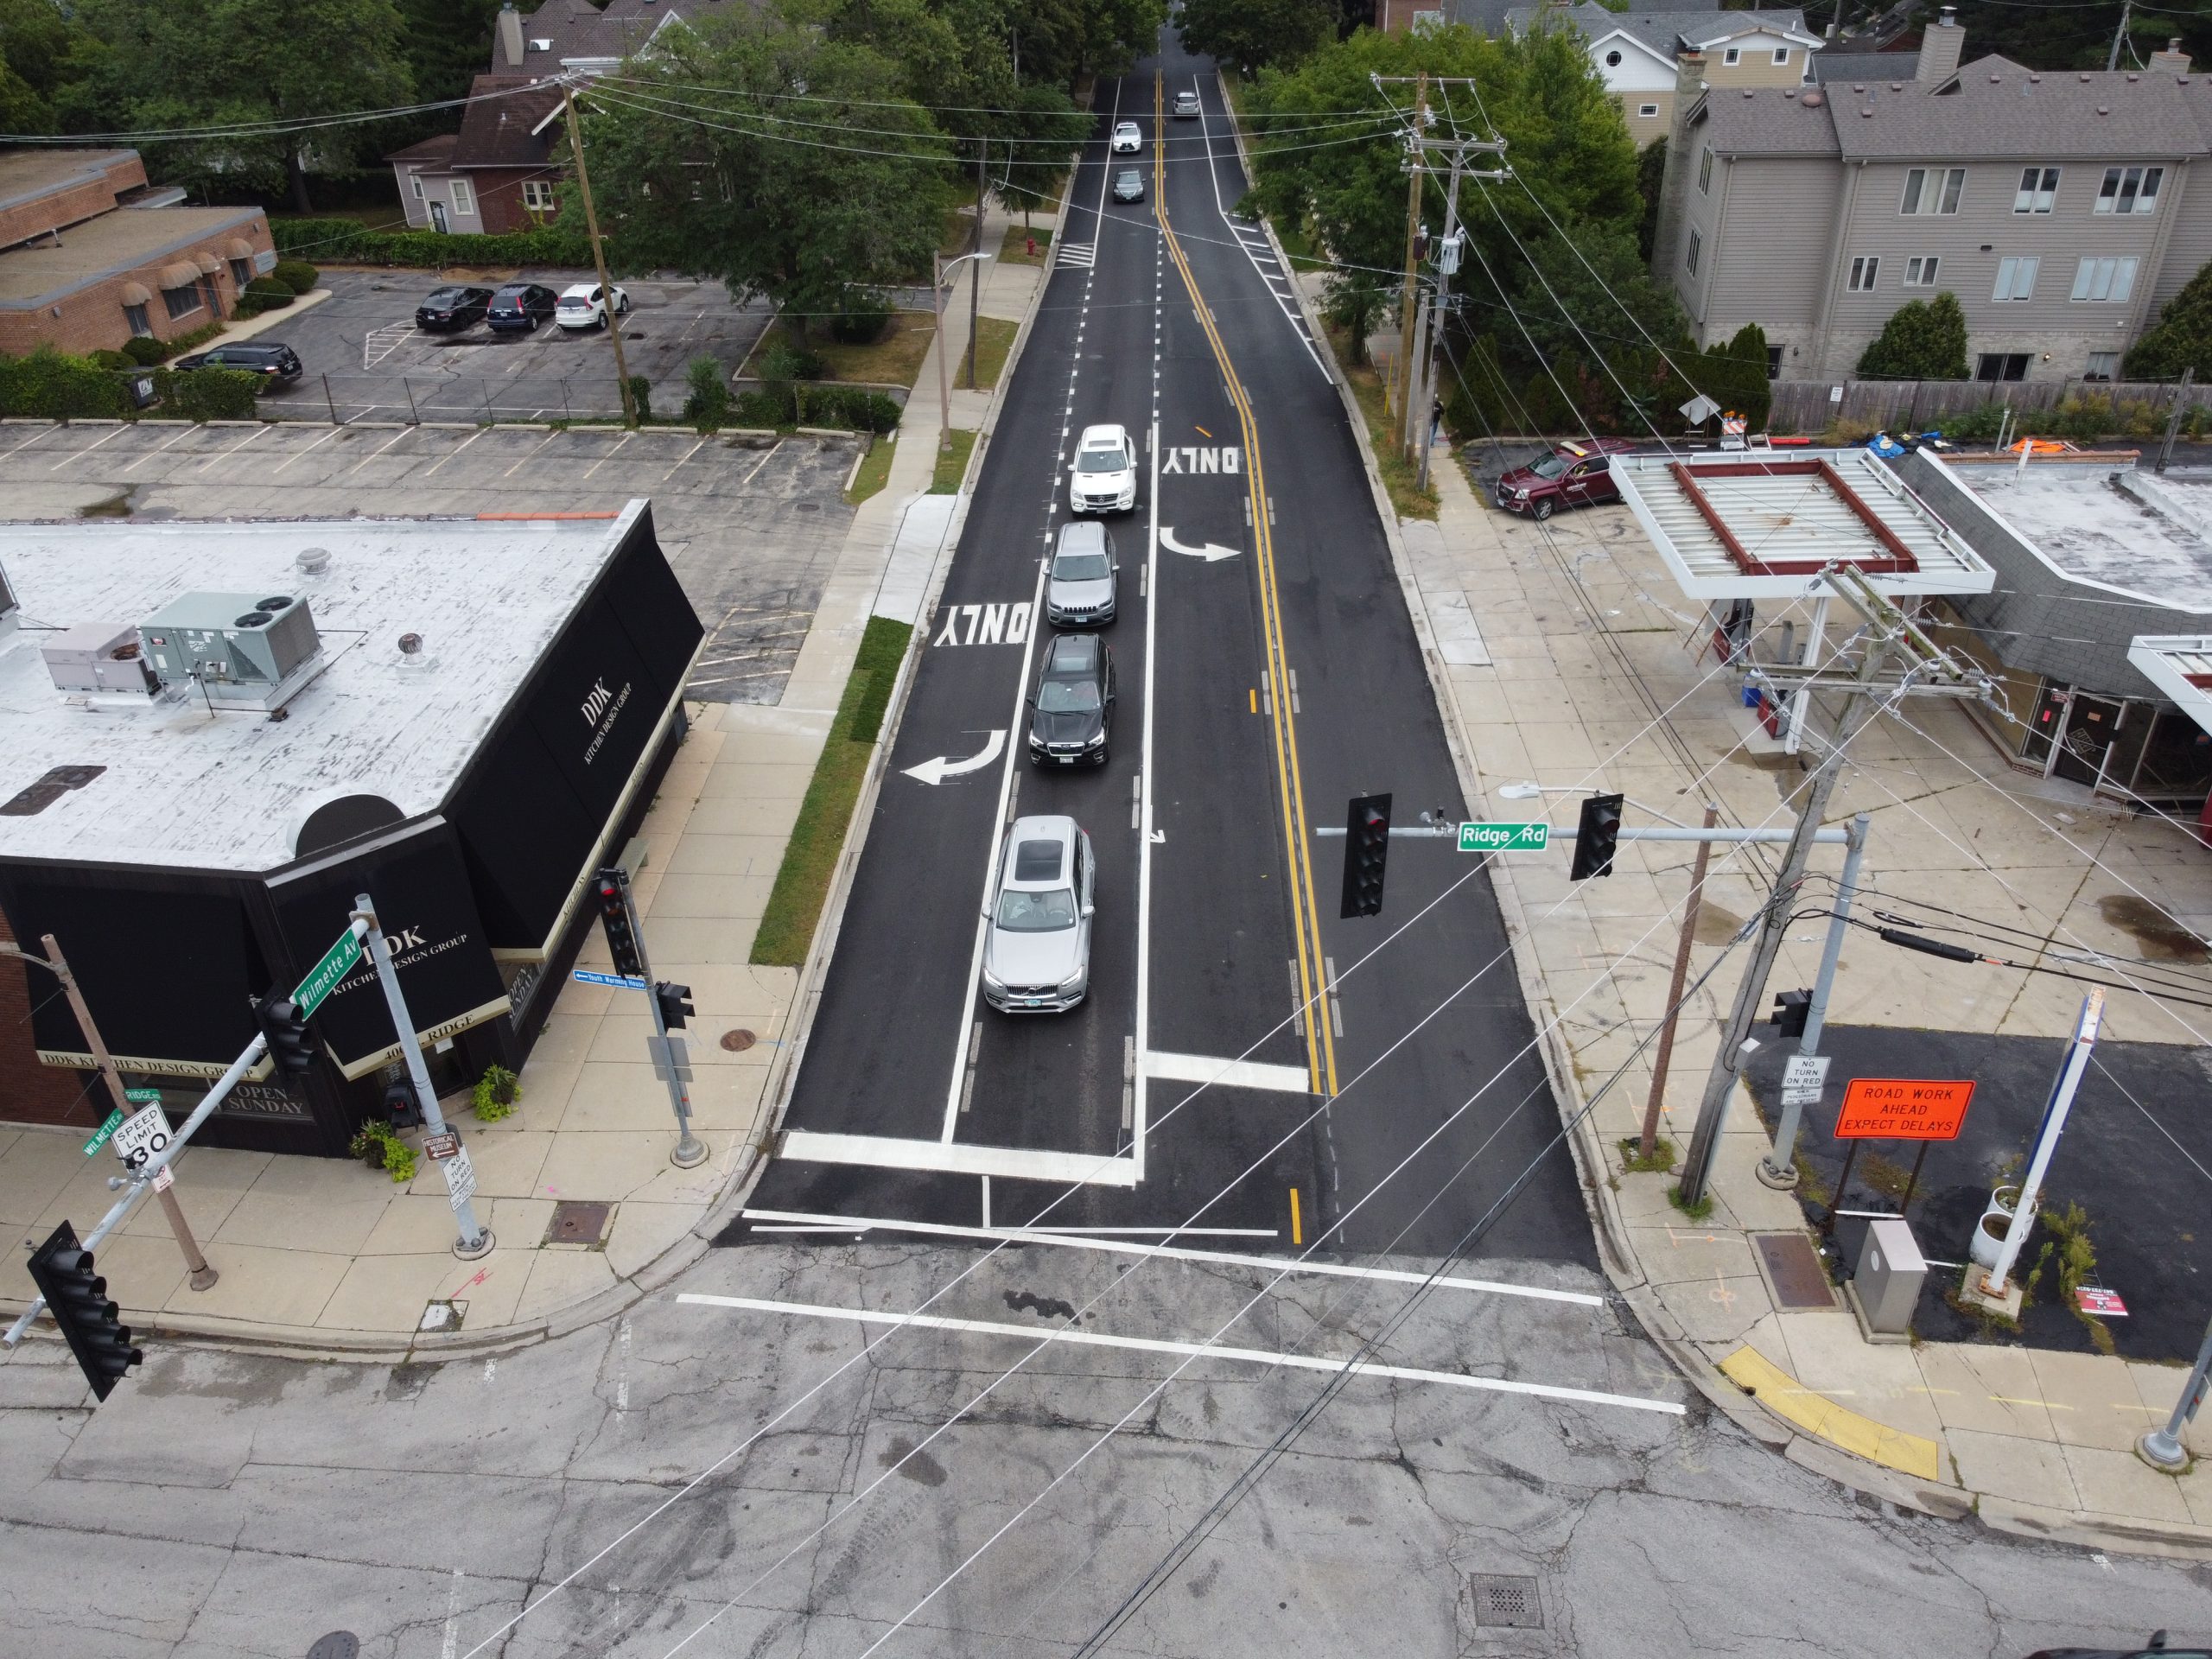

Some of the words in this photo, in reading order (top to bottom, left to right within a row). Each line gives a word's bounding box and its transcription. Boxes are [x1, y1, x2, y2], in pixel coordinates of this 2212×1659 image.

[1160, 447, 1239, 474] ONLY
[933, 602, 1032, 647] ONLY
[581, 676, 613, 728] DDK
[584, 728, 607, 765] KITCHEN
[601, 703, 620, 734] DESIGN
[616, 682, 632, 709] GROUP
[1462, 827, 1510, 847] Ridge
[1521, 827, 1545, 842] Rd
[429, 934, 467, 955] GROUP
[299, 954, 344, 1011] Wilmette
[346, 939, 356, 960] Av
[588, 974, 603, 982] Youth
[605, 976, 627, 987] Warming
[628, 979, 645, 988] House
[428, 1014, 475, 1041] RIDGE
[45, 1054, 76, 1065] DDK
[148, 1058, 200, 1074] DESIGN
[125, 1091, 152, 1100] RIDGE
[236, 1085, 288, 1100] OPEN
[1864, 1088, 1904, 1098] ROAD
[1912, 1089, 1955, 1100] WORK
[228, 1097, 303, 1114] SUNDAY
[1879, 1104, 1928, 1116] AHEAD
[117, 1109, 158, 1141] SPEED
[1844, 1119, 1896, 1130] EXPECT
[1901, 1120, 1954, 1131] DELAYS
[84, 1118, 119, 1156] WILMETTE
[126, 1122, 157, 1149] LIMIT
[423, 1135, 454, 1147] HISTORICAL
[130, 1133, 168, 1166] 30
[429, 1141, 453, 1153] MUSEUM
[451, 1155, 461, 1168] NO
[451, 1160, 466, 1178] TURN
[451, 1179, 460, 1192] ON
[461, 1165, 471, 1180] RED
